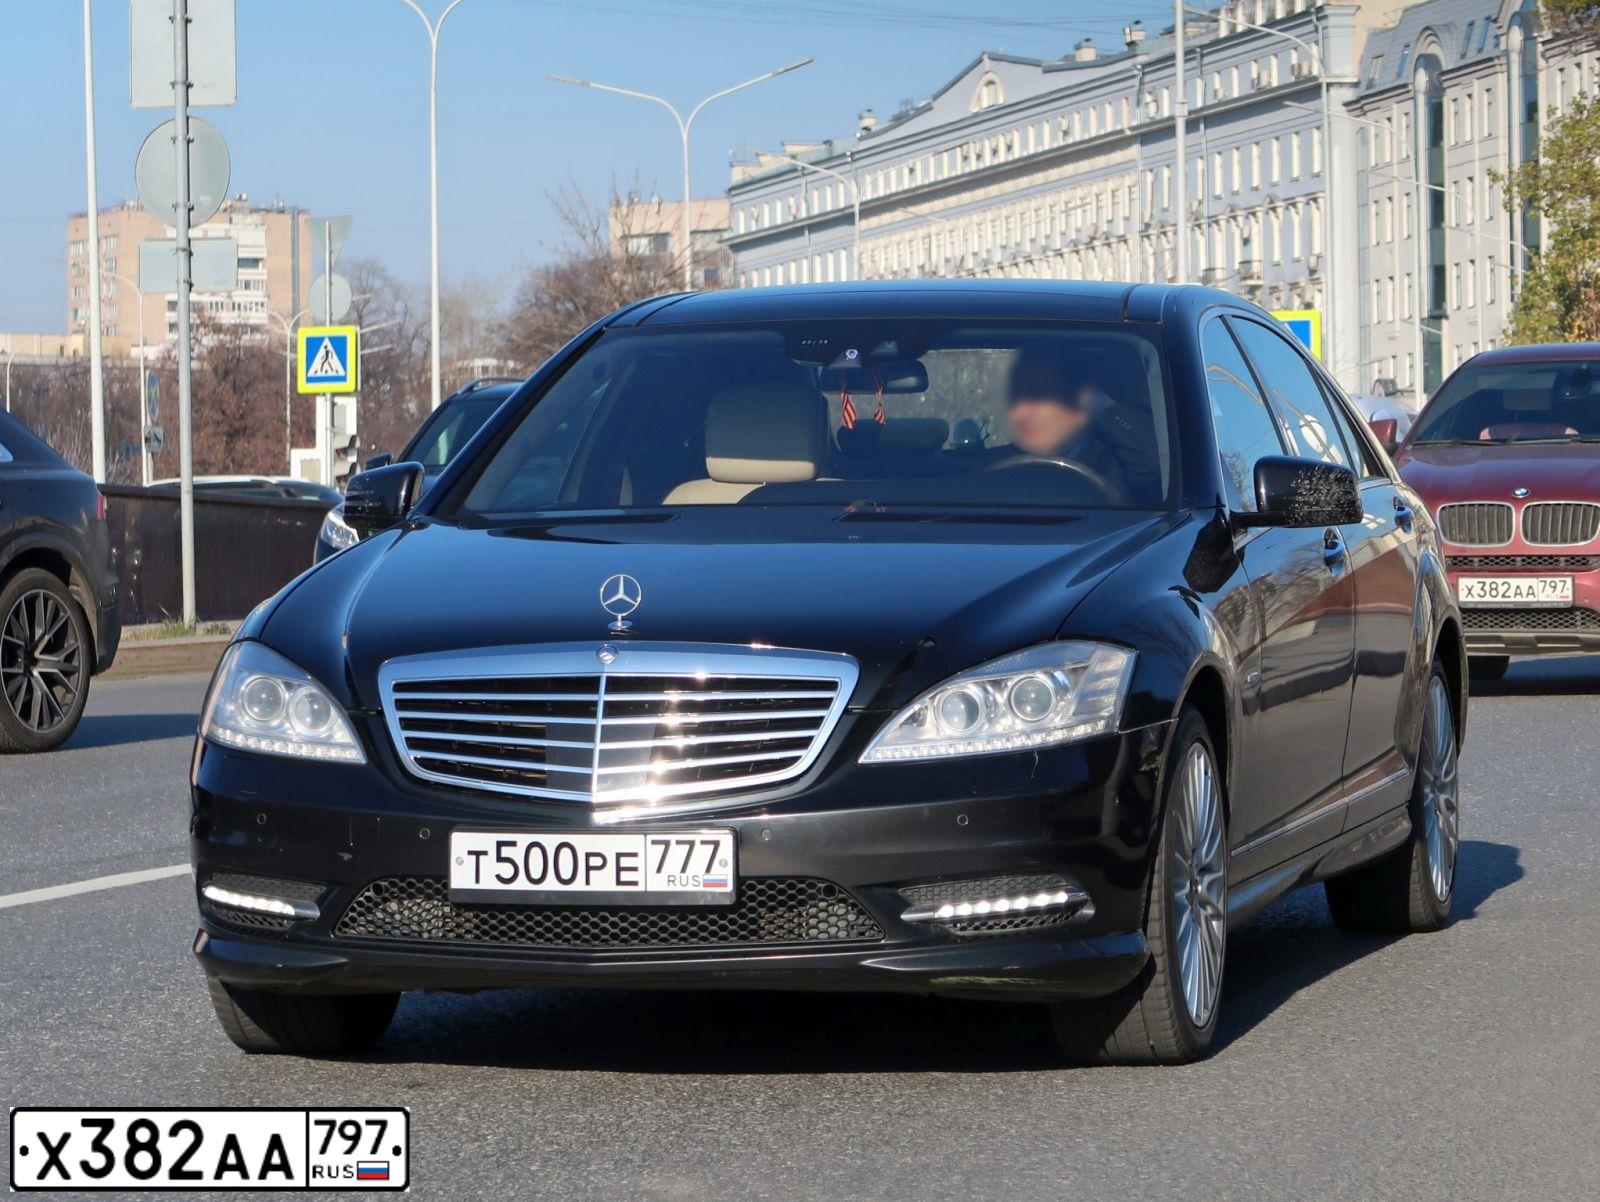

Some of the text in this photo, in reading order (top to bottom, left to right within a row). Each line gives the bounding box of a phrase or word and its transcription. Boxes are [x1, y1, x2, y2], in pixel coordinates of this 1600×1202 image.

[1539, 580, 1567, 594] 797
[466, 839, 721, 887] Т500РЕ 777
[667, 874, 702, 888] RUS
